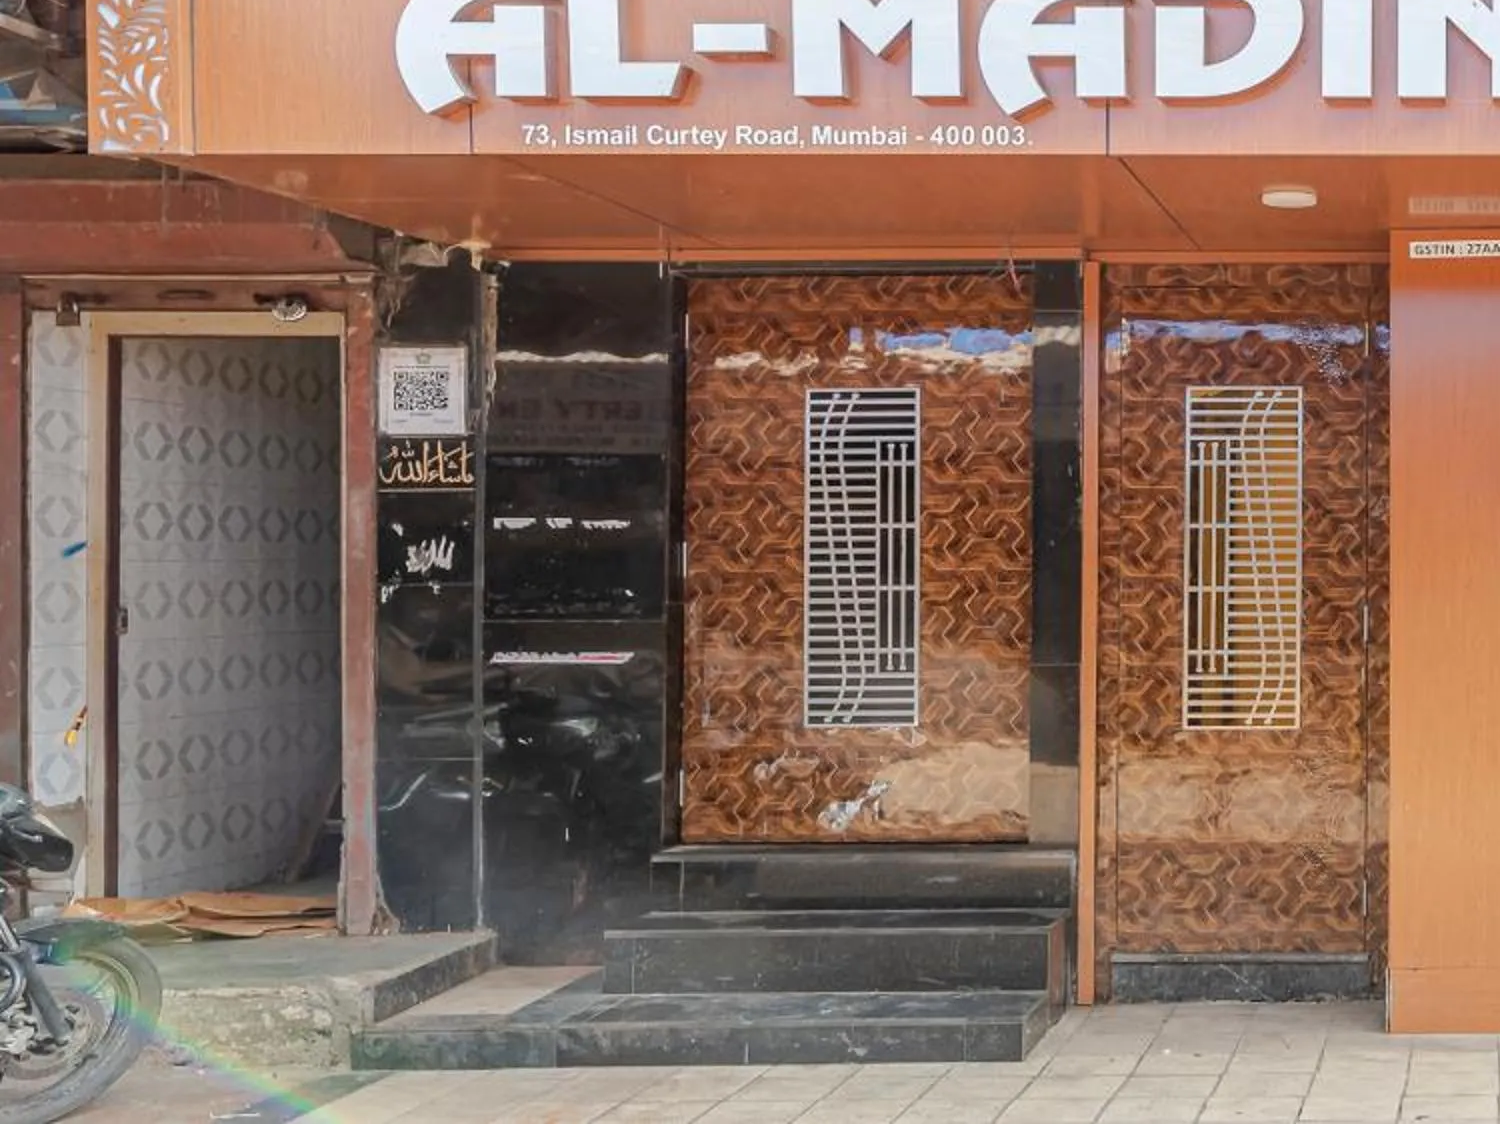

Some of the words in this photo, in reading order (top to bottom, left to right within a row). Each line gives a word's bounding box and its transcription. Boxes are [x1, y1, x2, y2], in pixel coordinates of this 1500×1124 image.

[521, 125, 557, 148] 73,
[564, 125, 638, 145] Ismail
[647, 124, 728, 150] Curtey
[735, 125, 805, 149] Road,
[812, 125, 908, 145] Mumbai
[929, 125, 975, 145] 400
[980, 125, 1034, 145] 003.
[1414, 243, 1456, 255] GSTIN
